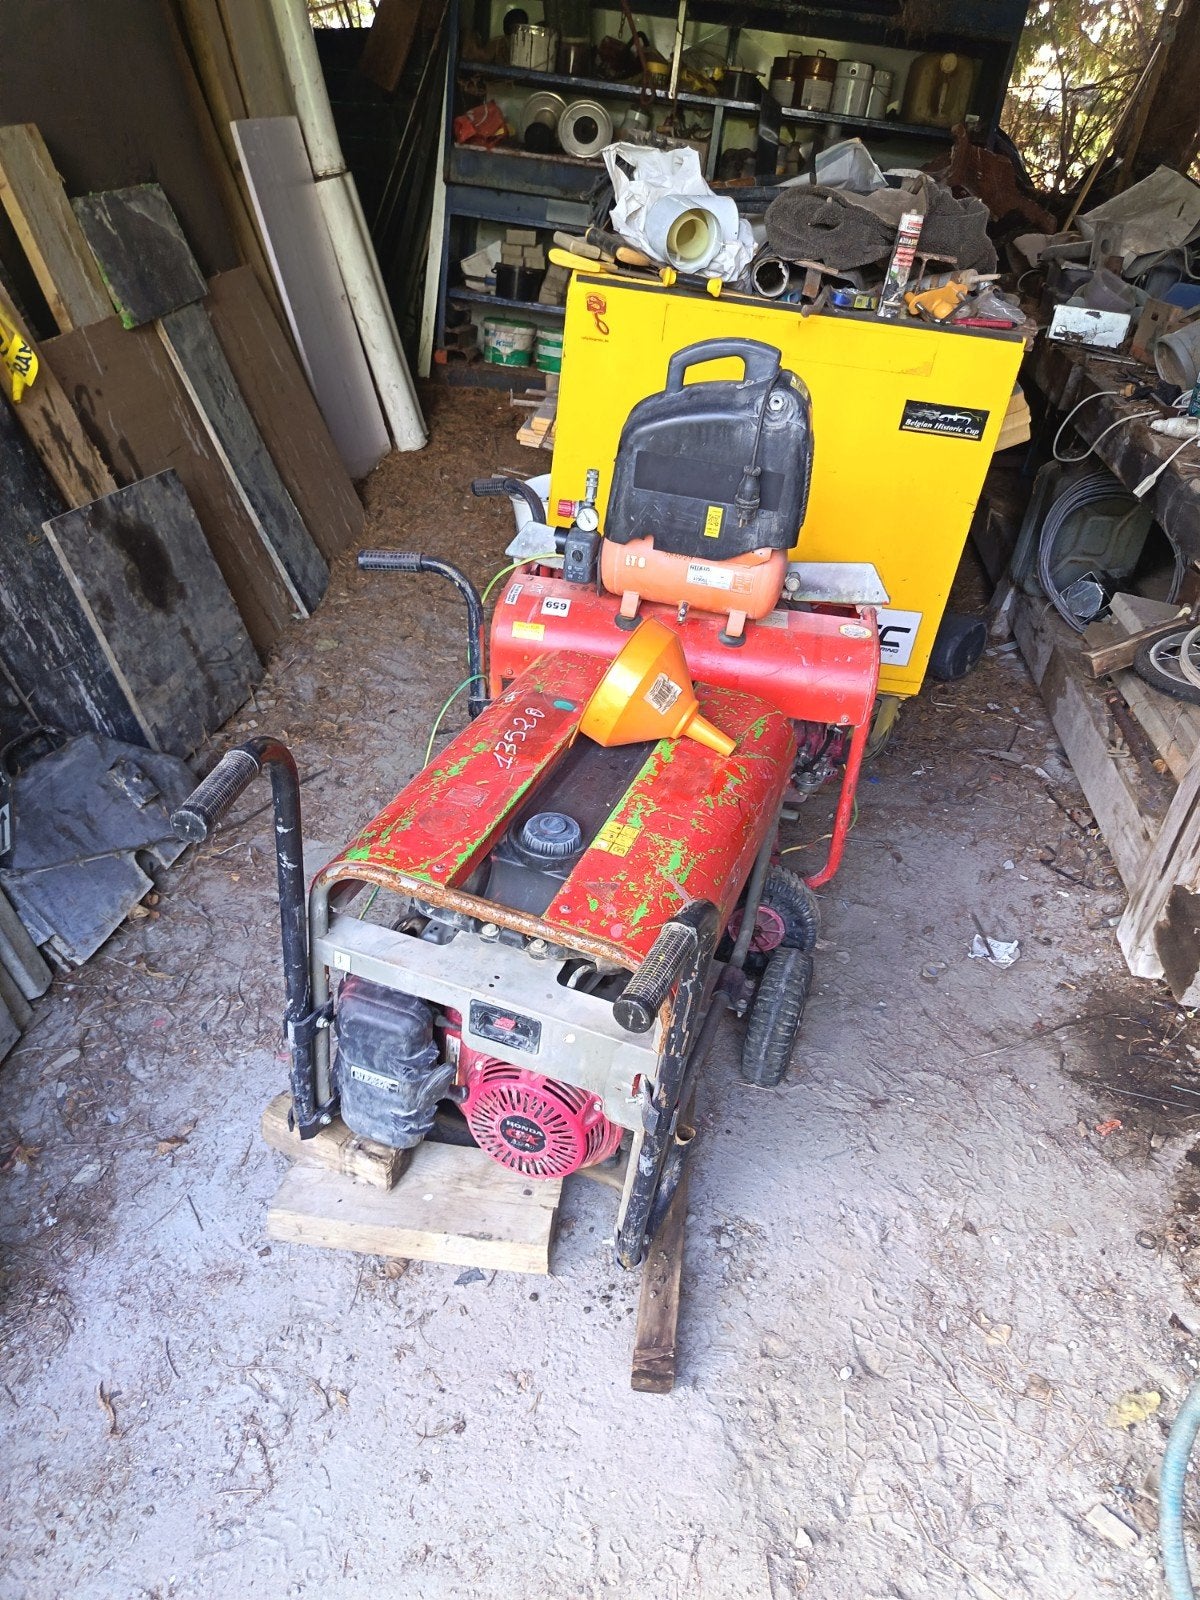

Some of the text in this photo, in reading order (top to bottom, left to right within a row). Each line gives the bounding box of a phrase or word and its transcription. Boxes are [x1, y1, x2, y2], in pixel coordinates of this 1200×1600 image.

[905, 418, 980, 436] Belgian Historic Cup
[545, 600, 567, 611] 659
[877, 624, 911, 648] C
[493, 707, 545, 770] 13520
[506, 1120, 544, 1137] HONDA
